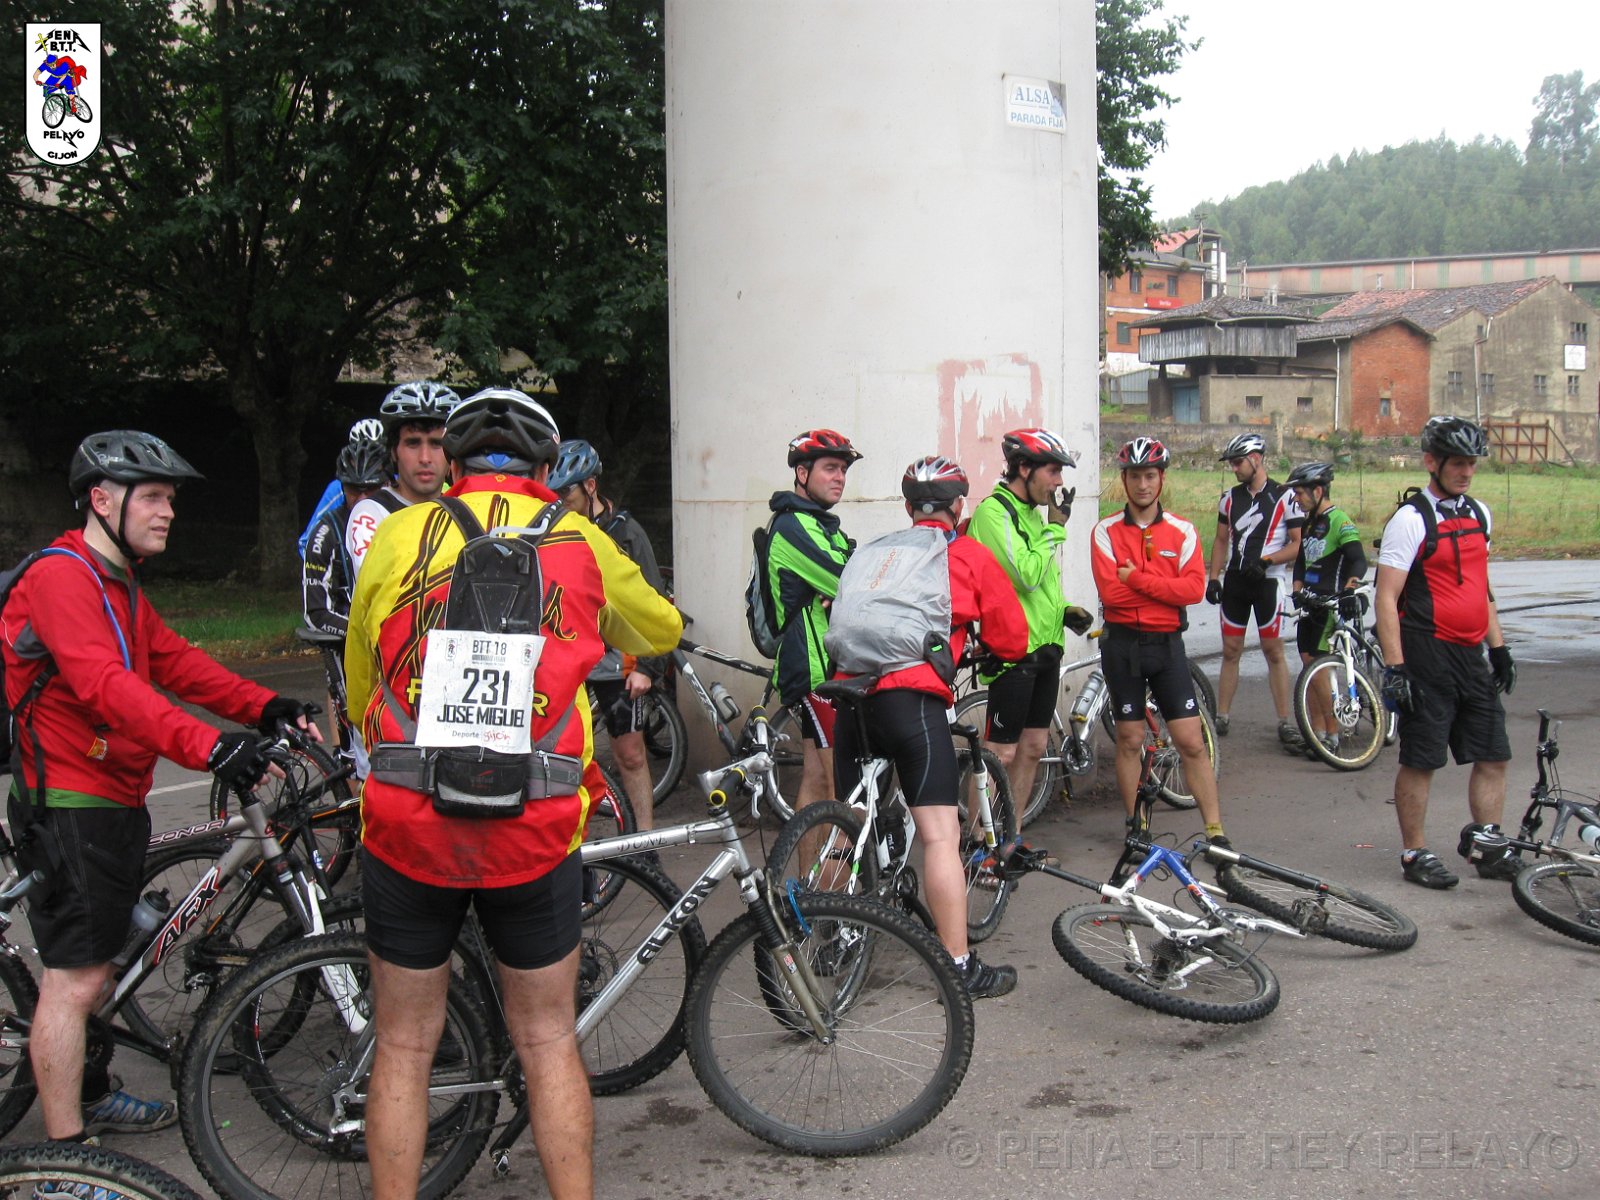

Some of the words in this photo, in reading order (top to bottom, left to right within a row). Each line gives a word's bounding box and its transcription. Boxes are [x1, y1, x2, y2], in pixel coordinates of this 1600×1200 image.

[1015, 86, 1050, 105] ALSA
[1010, 111, 1047, 126] PARADA
[472, 640, 492, 654] BTT
[494, 641, 507, 656] 18
[462, 668, 510, 706] 231
[437, 704, 475, 725] JOSE
[476, 706, 525, 728] MIGUEL
[452, 730, 480, 739] Deporte
[156, 868, 220, 964] AFX
